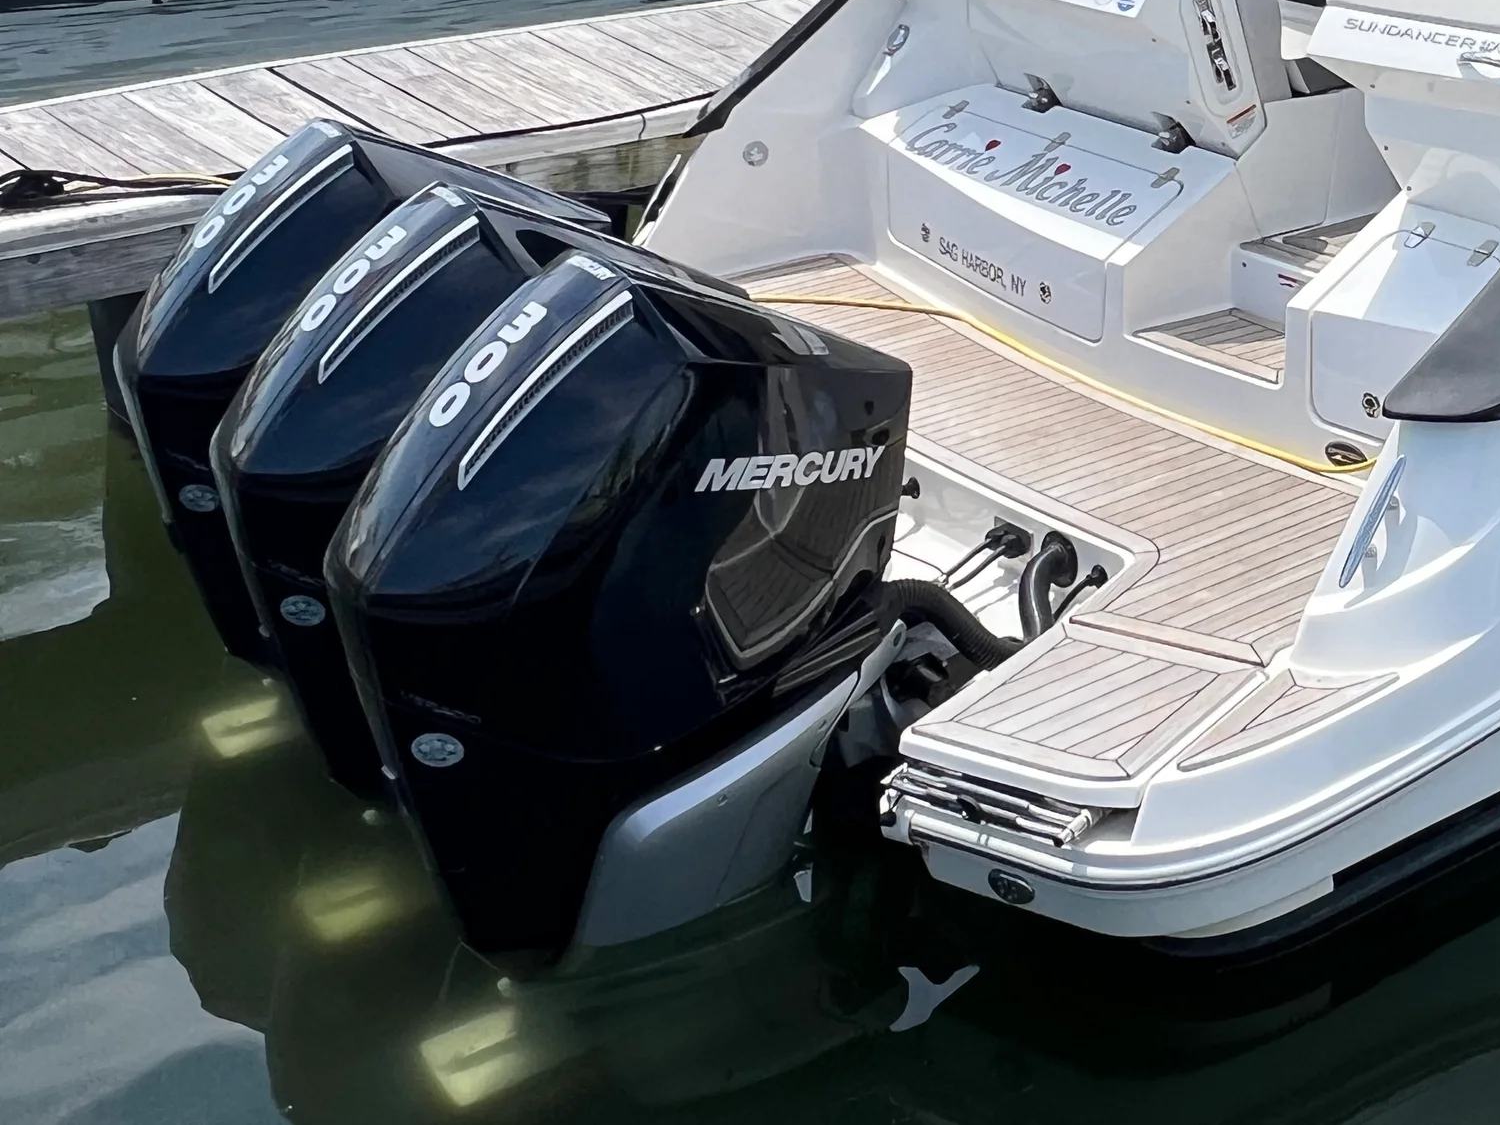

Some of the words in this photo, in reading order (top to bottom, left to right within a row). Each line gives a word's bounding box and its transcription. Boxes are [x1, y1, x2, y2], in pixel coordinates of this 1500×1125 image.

[1343, 17, 1476, 49] SUNDANCER
[192, 154, 288, 250] 300
[905, 122, 1001, 176] Carrie
[984, 153, 1137, 227] Michelle
[300, 225, 407, 332] 300
[939, 236, 959, 263] SAG
[1010, 274, 1027, 297] NY
[429, 301, 548, 428] 300
[694, 445, 886, 492] MERCURY
